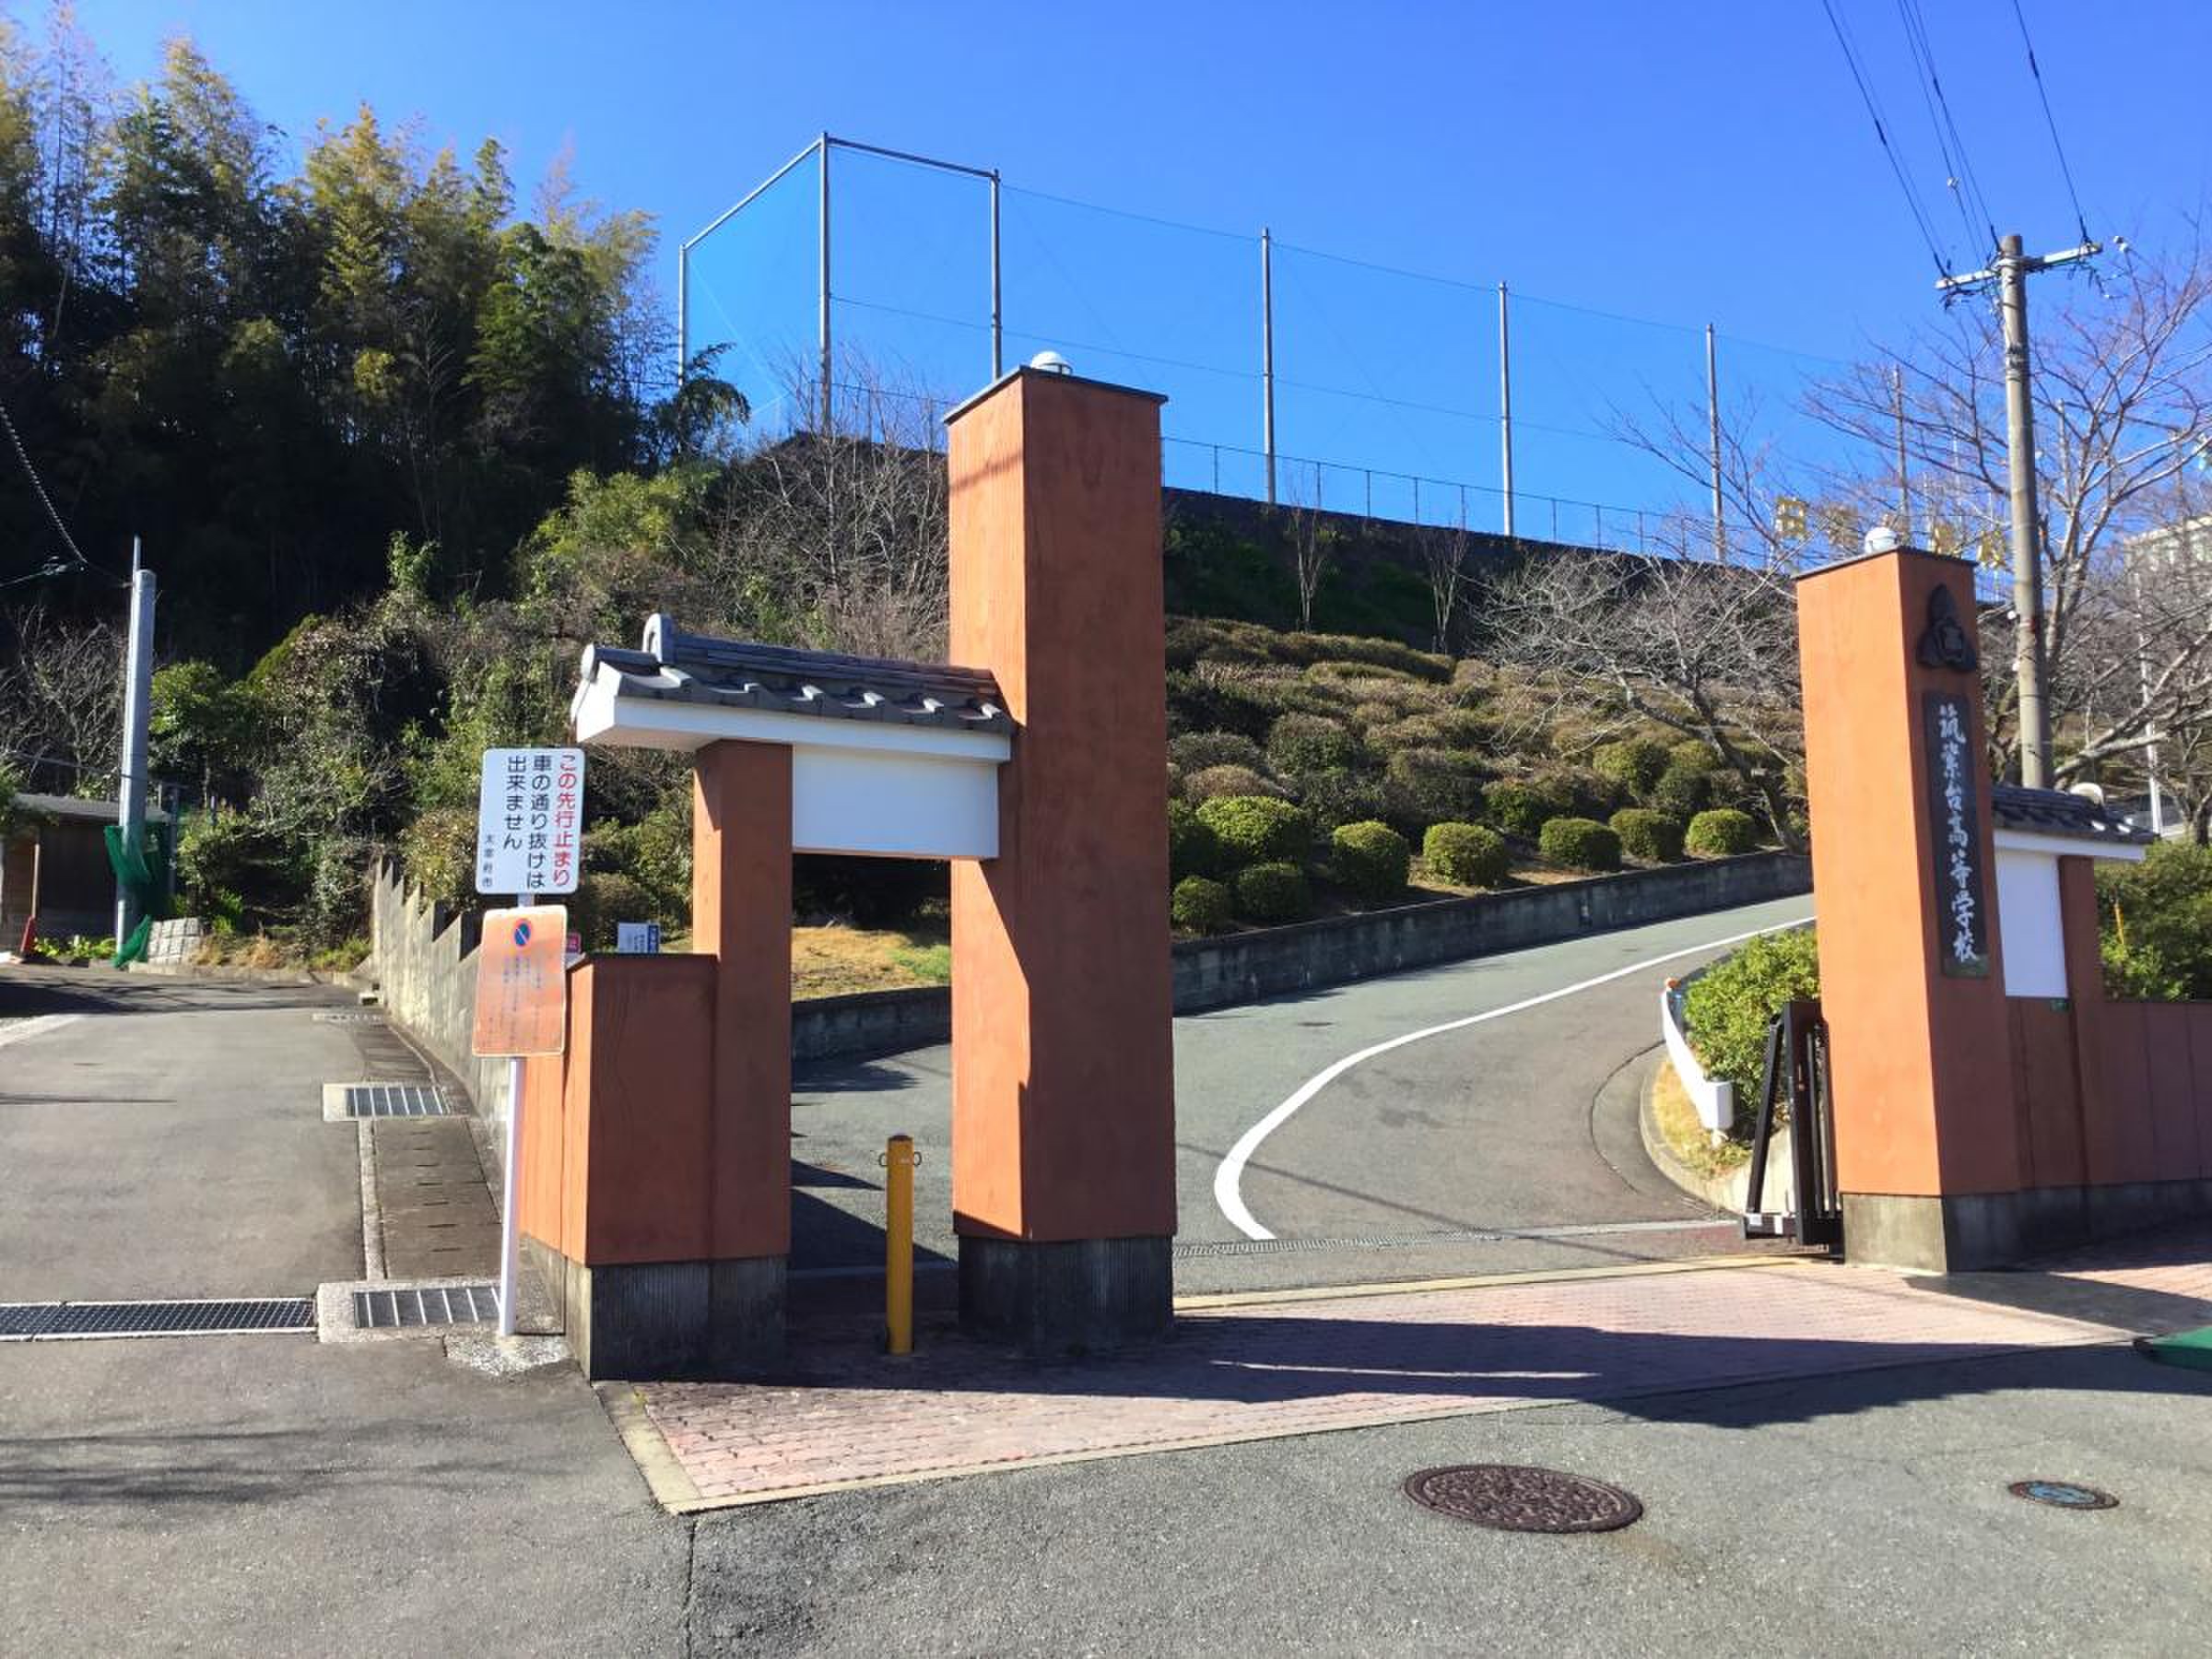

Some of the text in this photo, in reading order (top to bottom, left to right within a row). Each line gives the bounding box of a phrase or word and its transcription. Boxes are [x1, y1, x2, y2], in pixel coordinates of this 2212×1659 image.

[503, 755, 526, 850] 出来ません
[527, 755, 552, 888] 車の通り抜けは
[553, 755, 577, 886] この先行止まり
